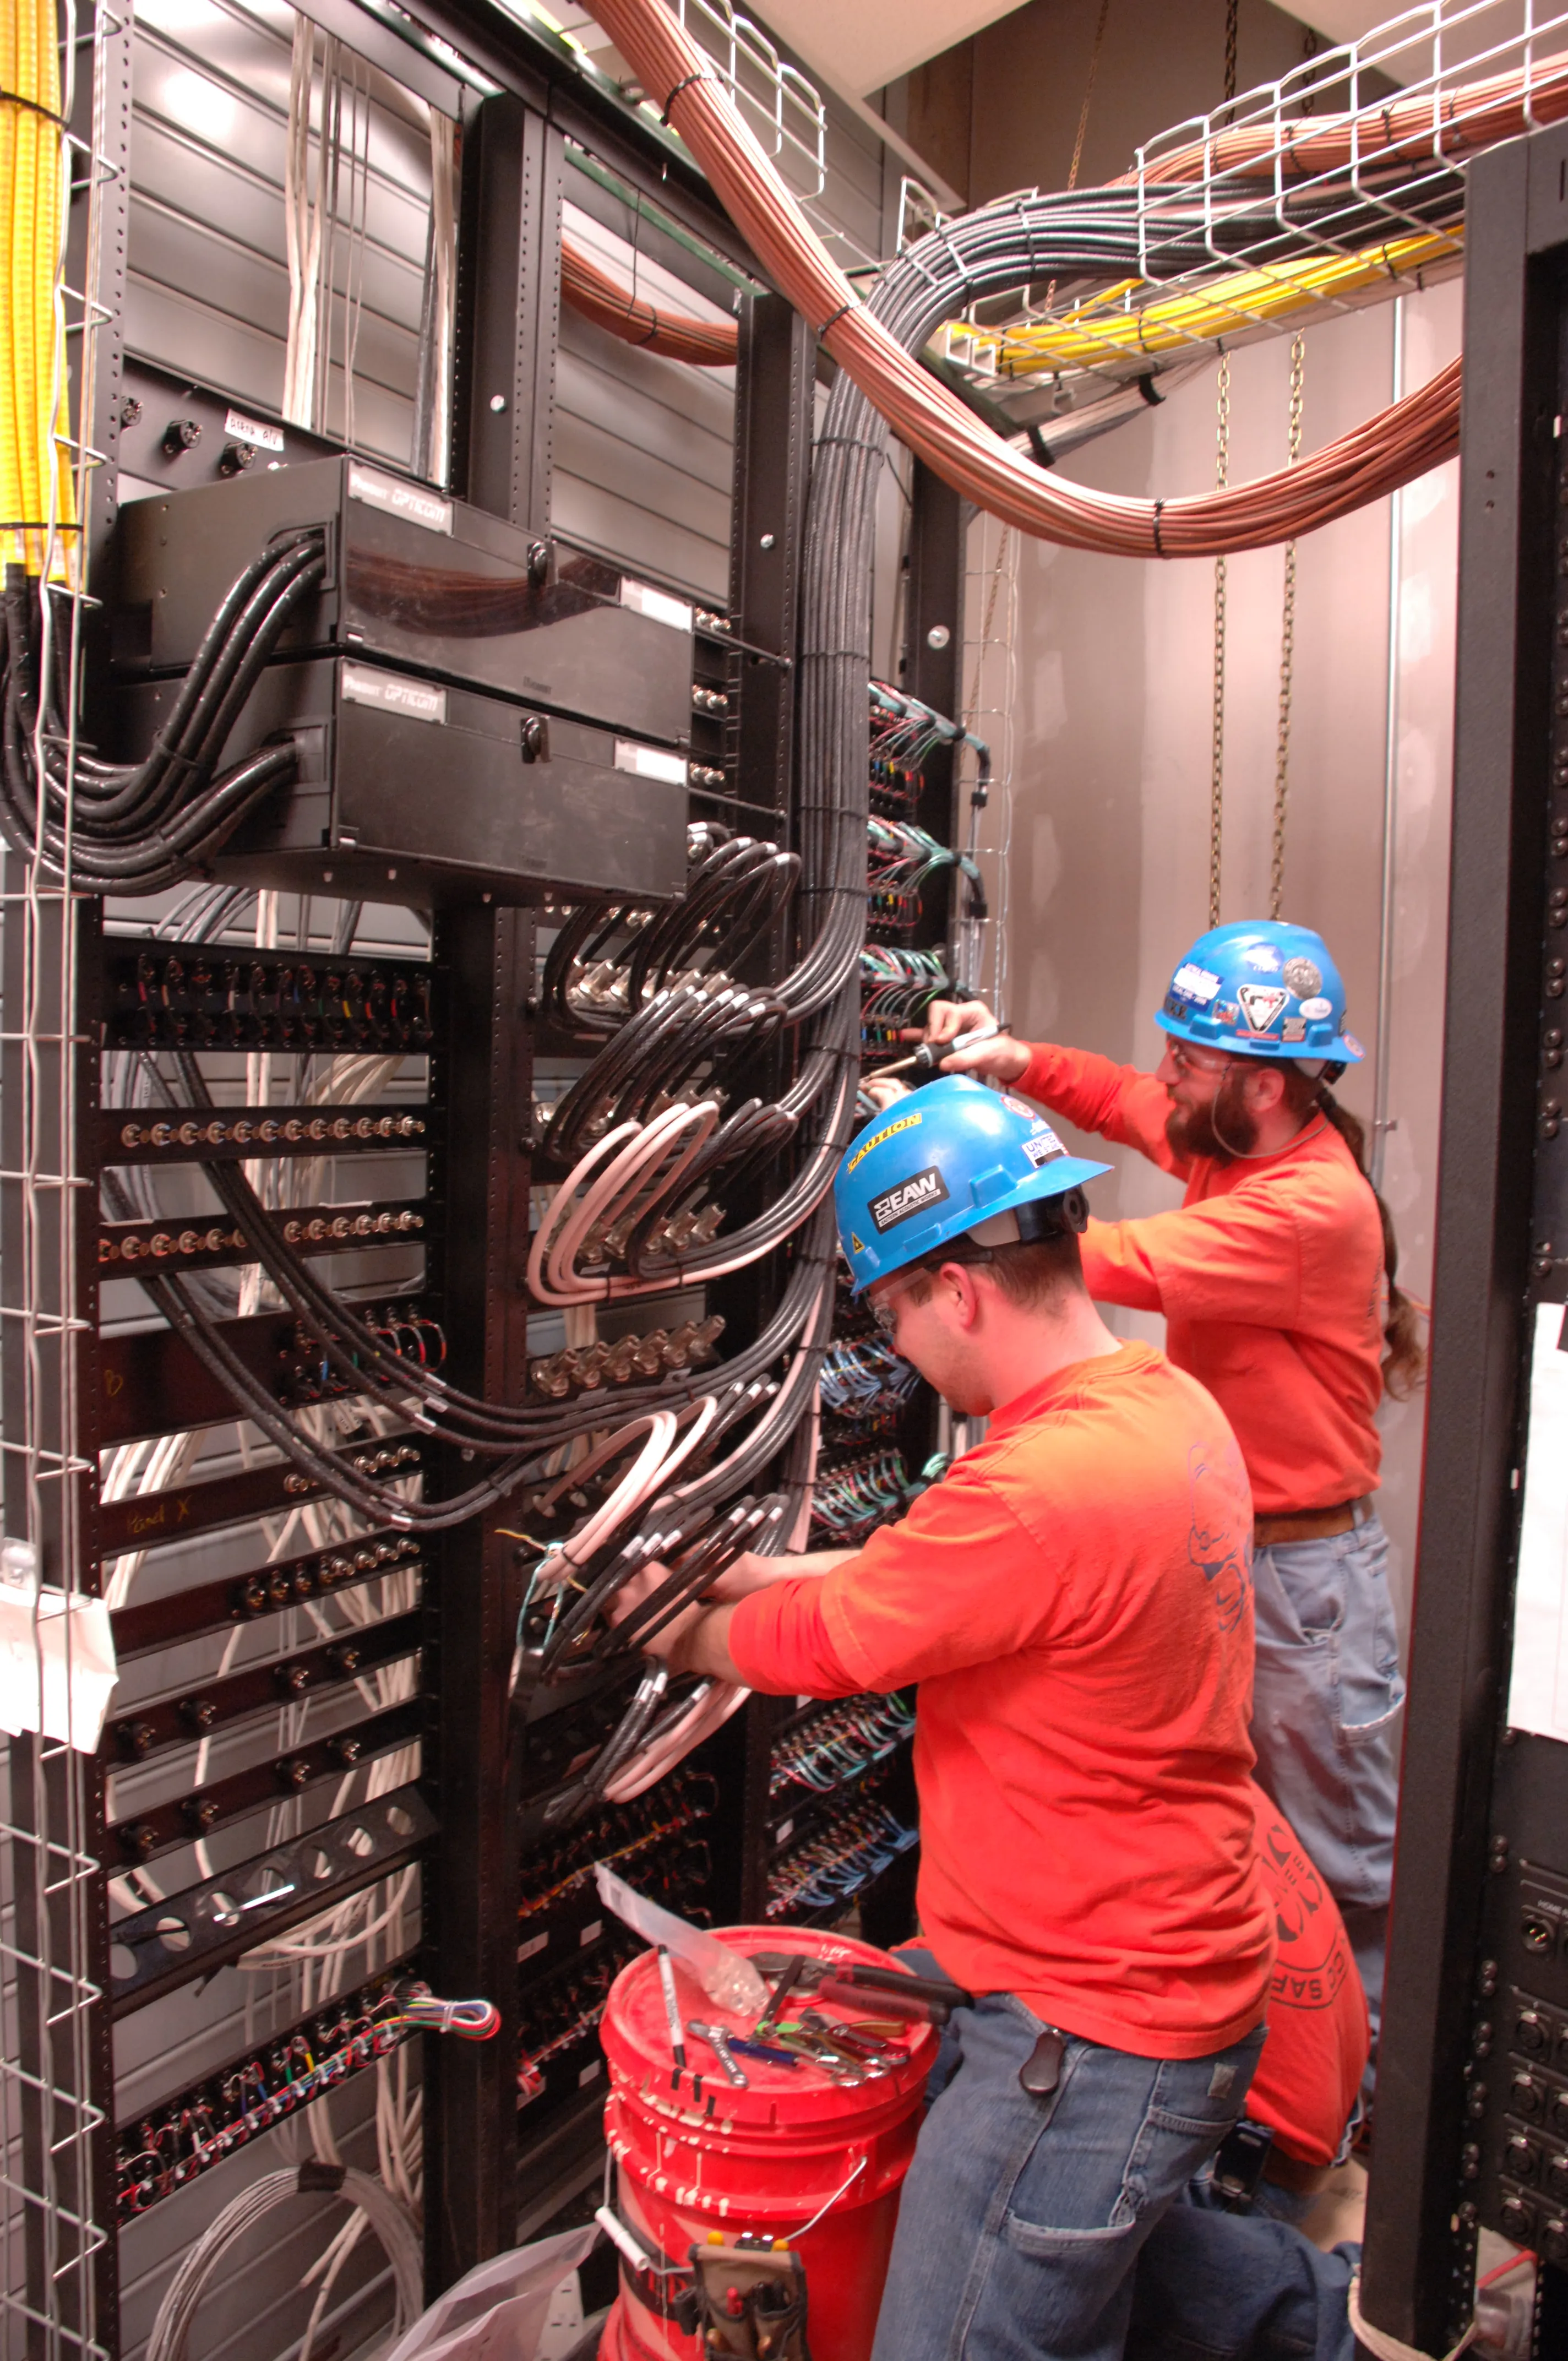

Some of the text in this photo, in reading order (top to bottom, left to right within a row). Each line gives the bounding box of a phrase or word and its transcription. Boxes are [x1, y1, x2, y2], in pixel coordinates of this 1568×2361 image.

[848, 1113, 922, 1173] CAUTION
[881, 1191, 938, 1225] EASTERN ACOUSTIC WORKS
[889, 1173, 937, 1212] EAW
